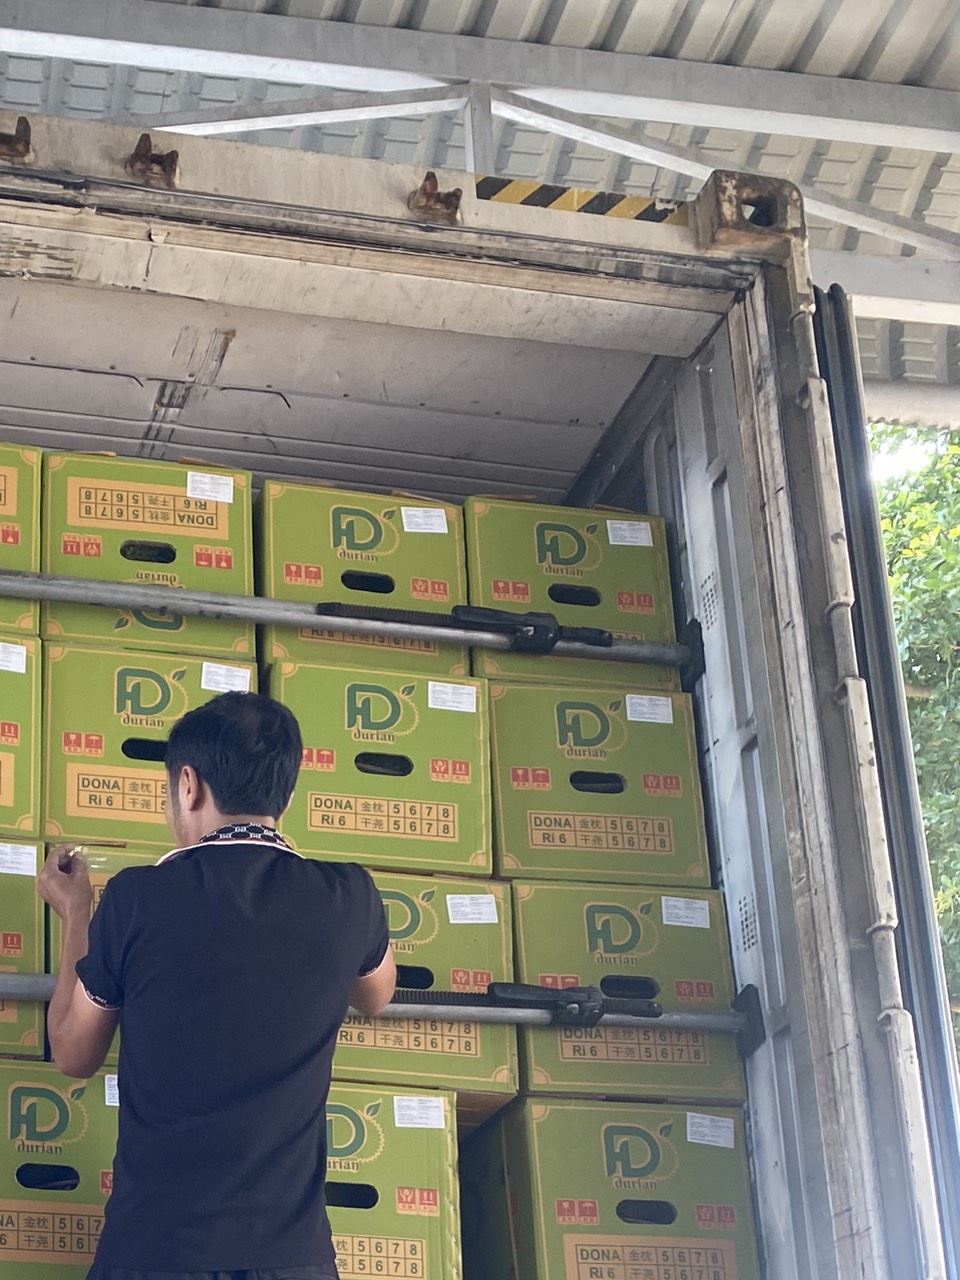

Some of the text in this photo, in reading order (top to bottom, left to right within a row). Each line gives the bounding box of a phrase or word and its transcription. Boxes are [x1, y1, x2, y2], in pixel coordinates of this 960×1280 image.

[339, 548, 379, 561] durian
[546, 563, 584, 576] durian
[123, 714, 164, 727] durian
[353, 728, 395, 742] durian
[567, 746, 606, 758] durian
[314, 797, 449, 818] DONA 金枕 5 6 7 8
[321, 814, 334, 825] Ri
[338, 815, 345, 826] 6
[393, 820, 400, 830] 5
[409, 821, 416, 831] 6
[426, 822, 433, 833] 7
[442, 824, 449, 834] 8
[18, 1140, 62, 1154] durian
[614, 1177, 657, 1189] durian
[579, 1248, 621, 1261] DONA
[662, 1251, 669, 1262] 5
[678, 1251, 686, 1262] 6
[695, 1252, 702, 1263] 7
[712, 1252, 719, 1264] 8
[606, 1267, 614, 1278] 6
[663, 1269, 670, 1280] 5
[680, 1269, 687, 1280] 6
[696, 1270, 703, 1280] 7
[713, 1270, 720, 1280] 8
